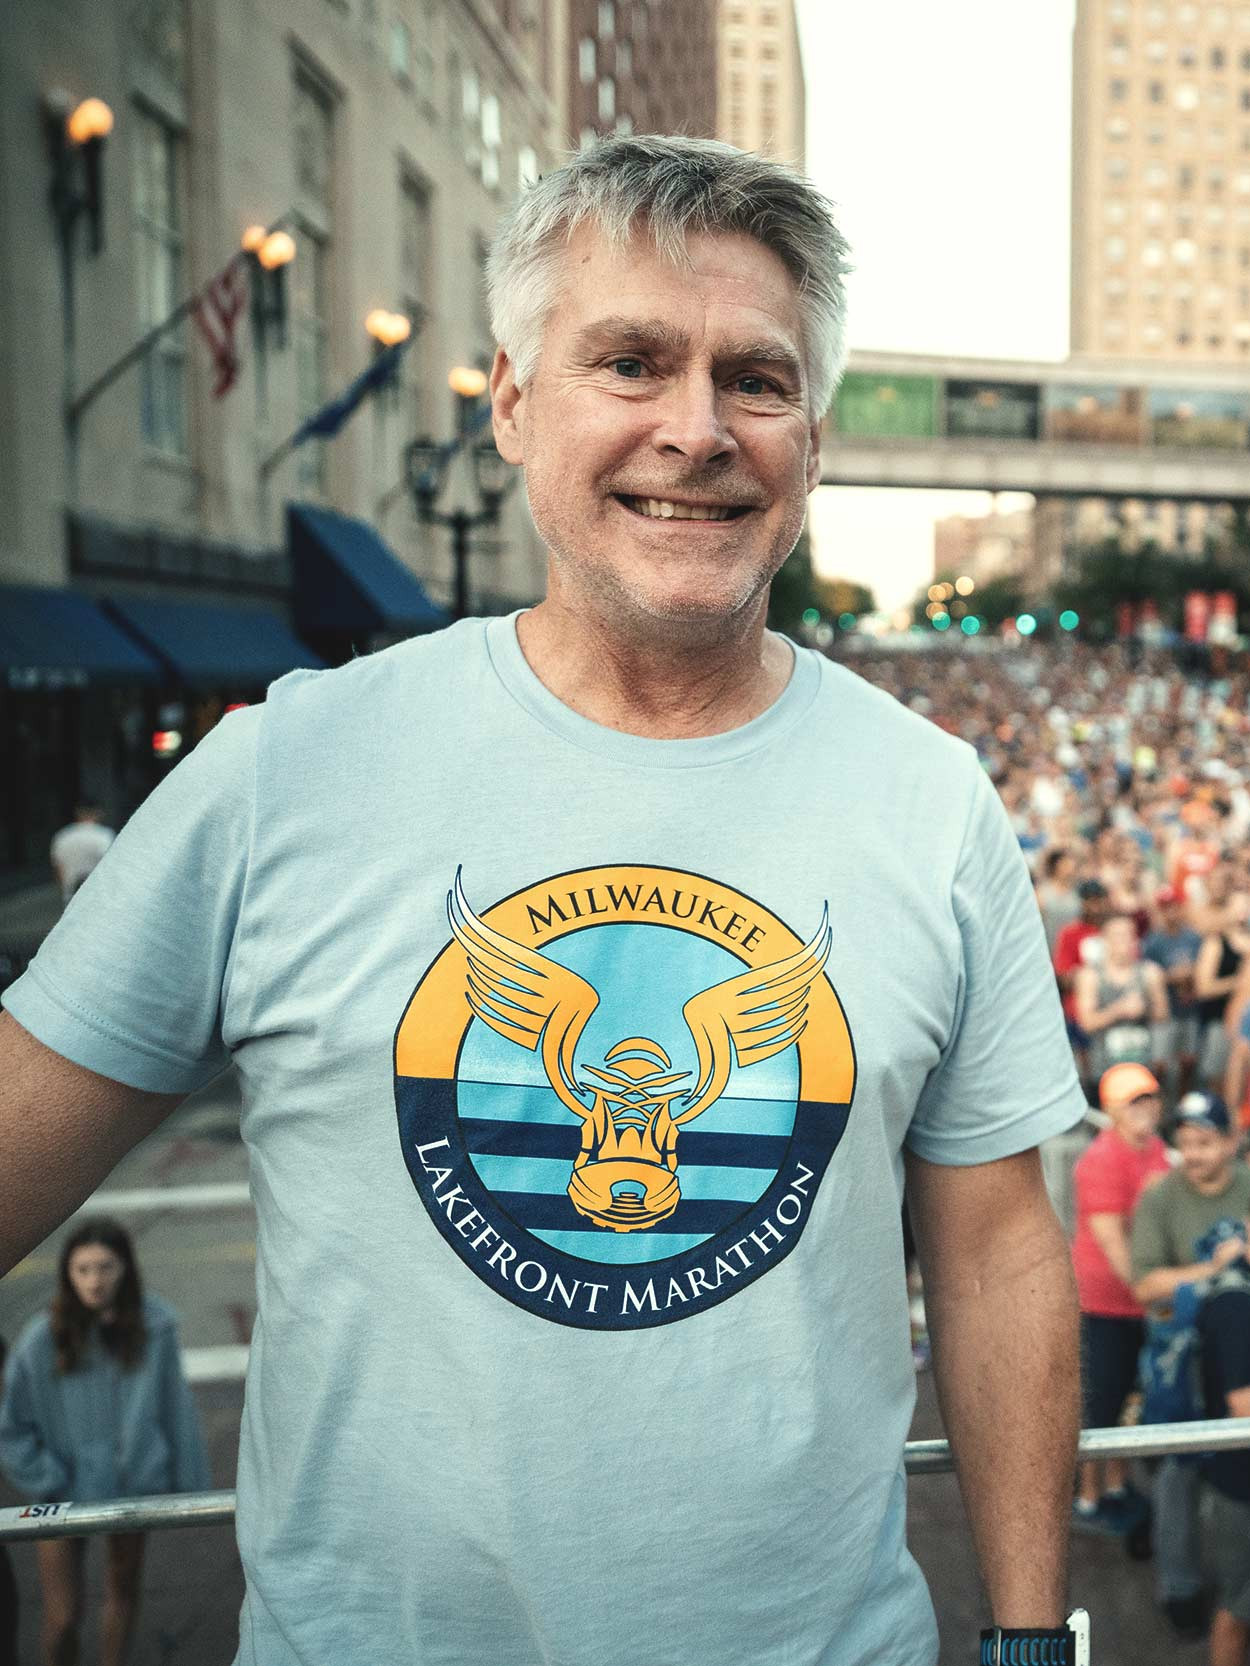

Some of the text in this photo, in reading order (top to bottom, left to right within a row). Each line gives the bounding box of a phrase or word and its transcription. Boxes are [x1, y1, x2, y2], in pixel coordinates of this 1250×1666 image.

[525, 884, 767, 953] MILWAUKEE
[415, 1135, 816, 1316] LAKEFRONT MARATHON
